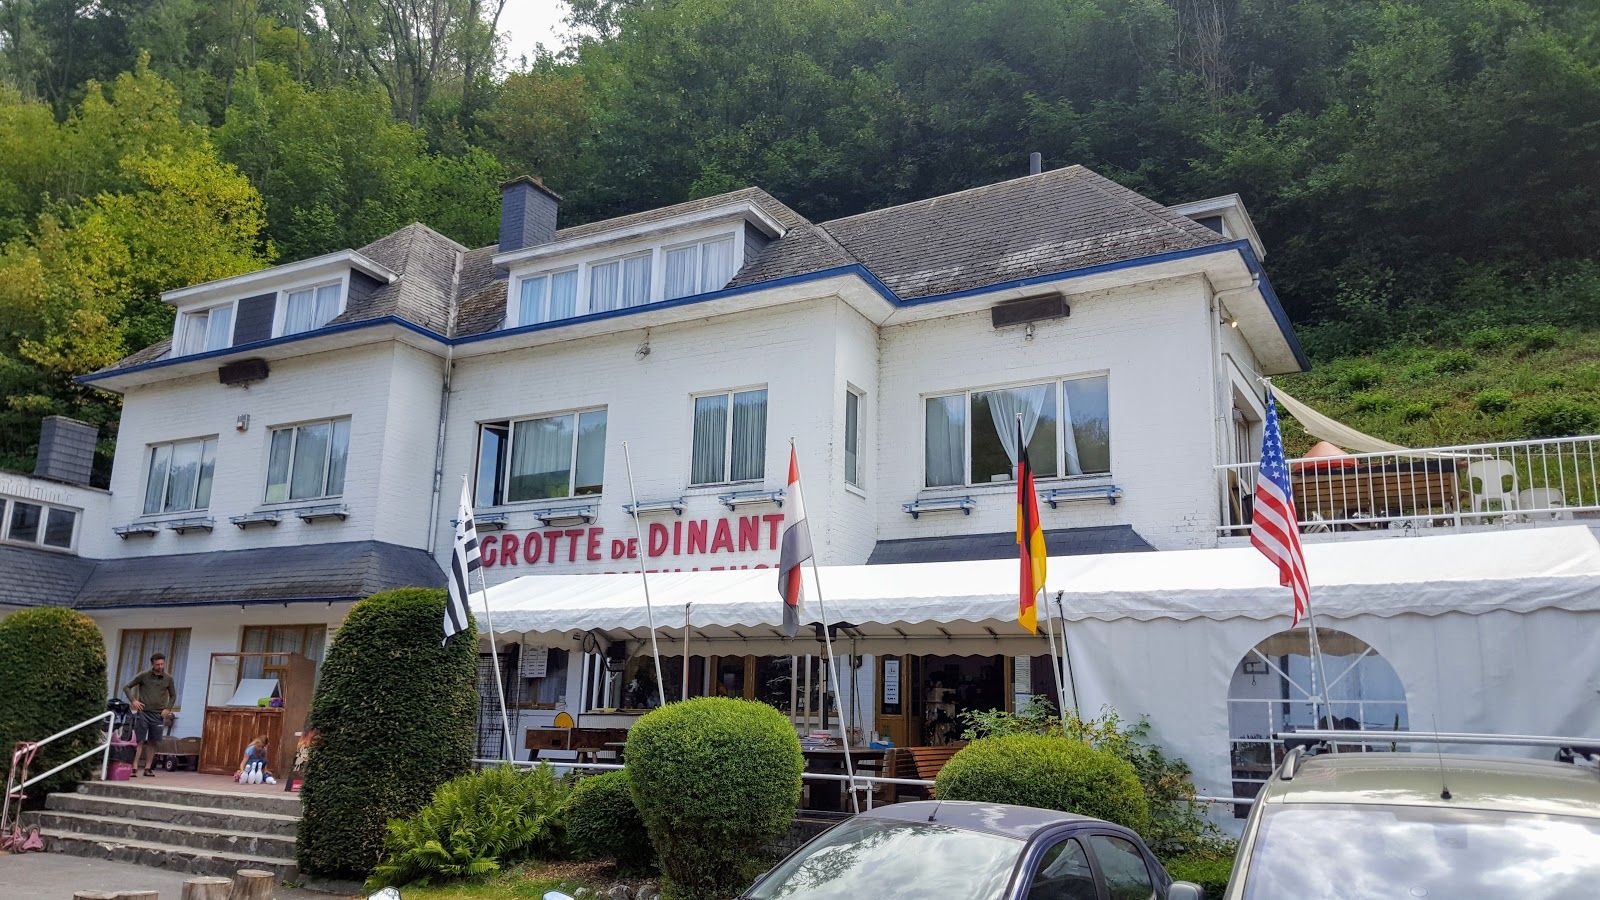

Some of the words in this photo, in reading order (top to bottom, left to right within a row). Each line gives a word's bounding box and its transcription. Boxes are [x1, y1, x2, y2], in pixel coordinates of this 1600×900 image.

[480, 527, 604, 567] GROTTE
[611, 538, 638, 559] DE
[648, 514, 785, 557] DINANT
